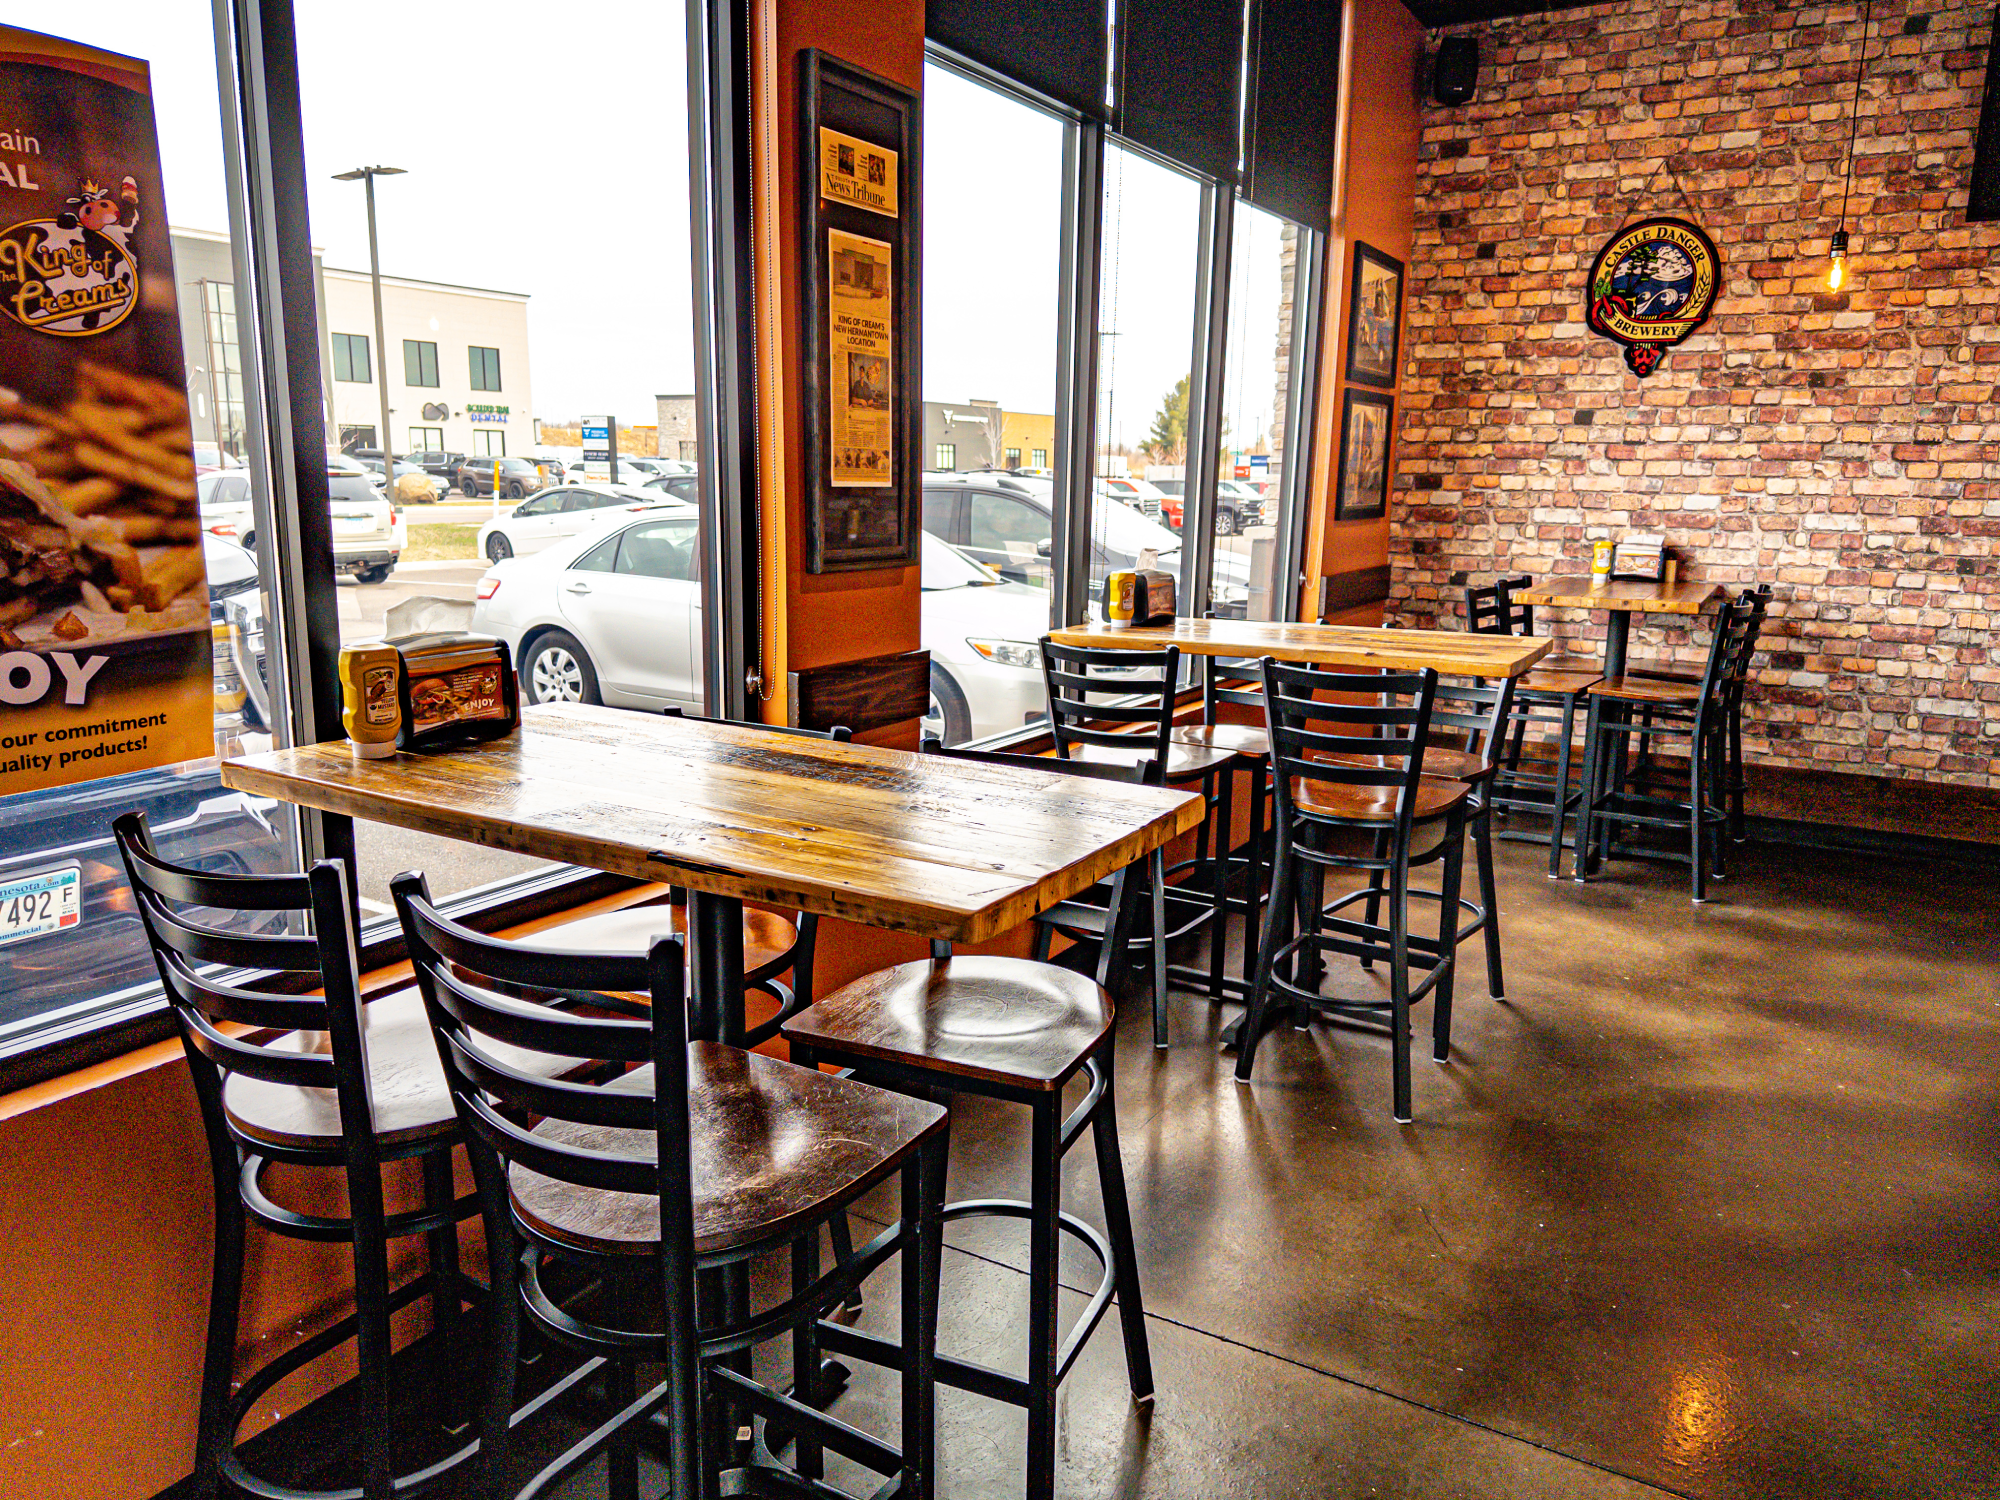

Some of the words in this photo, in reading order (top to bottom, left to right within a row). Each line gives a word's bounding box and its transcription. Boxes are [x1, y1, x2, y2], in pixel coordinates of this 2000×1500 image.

[825, 172, 851, 197] News
[850, 180, 886, 207] Tribune
[1605, 230, 1651, 269] CASTLE
[1656, 227, 1705, 264] DANGER
[0, 233, 92, 283] King
[92, 250, 113, 281] of
[11, 278, 131, 326] Creams
[838, 314, 852, 325] KING
[853, 318, 861, 326] OF
[1614, 319, 1680, 336] BREWERY
[833, 324, 847, 334] NEW
[848, 326, 889, 341] HERMANTOWN
[847, 336, 876, 348] LOCATION
[471, 412, 509, 424] DENTAL
[464, 698, 495, 711] ENJOY
[1, 733, 38, 749] our
[45, 712, 167, 743] commitment
[59, 735, 148, 769] products!
[63, 886, 74, 903] F
